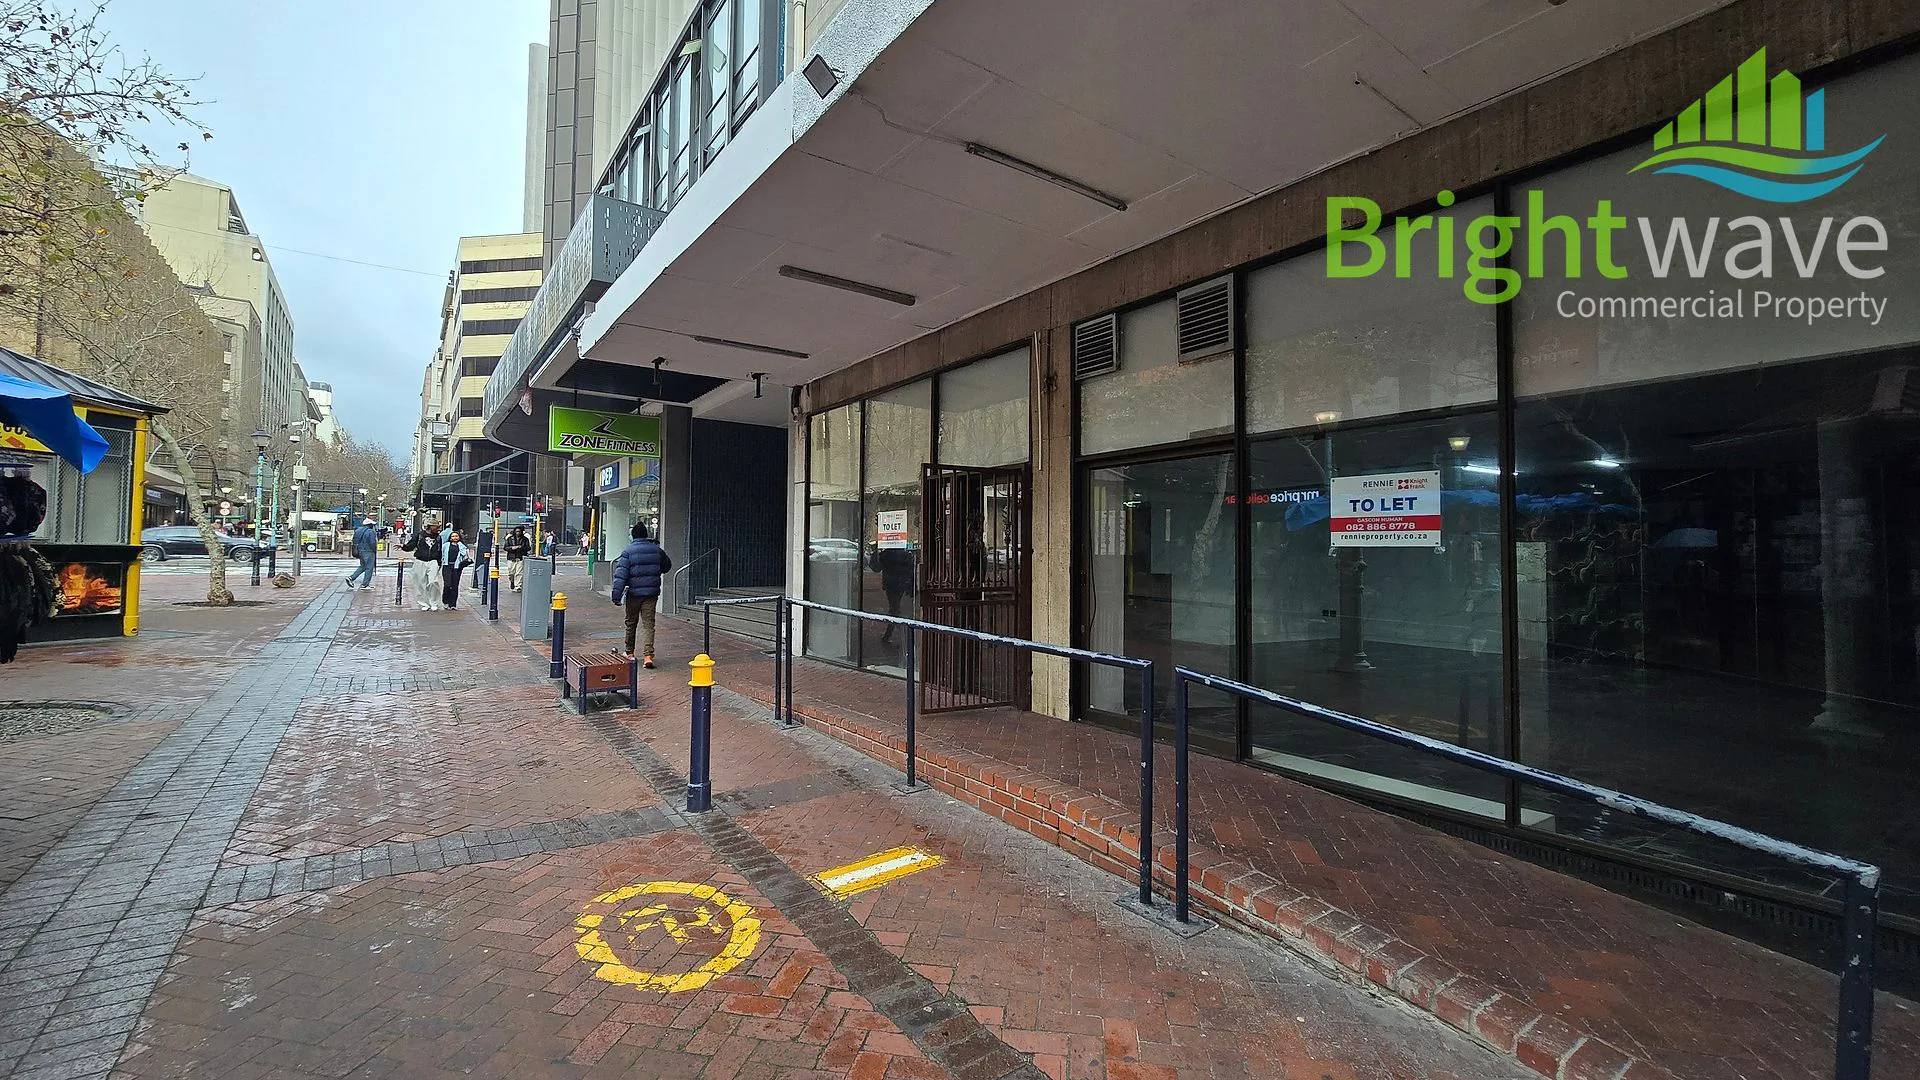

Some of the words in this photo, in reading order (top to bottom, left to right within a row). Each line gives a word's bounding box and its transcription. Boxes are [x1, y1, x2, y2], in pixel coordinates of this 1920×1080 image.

[1362, 479, 1394, 488] RENNIE
[1349, 498, 1375, 513] TO
[1380, 496, 1418, 512] LET
[1346, 523, 1365, 531] 082
[1366, 523, 1387, 531] 886
[1388, 522, 1416, 530] 8778
[1340, 533, 1428, 541] rennieproperty.co.za
